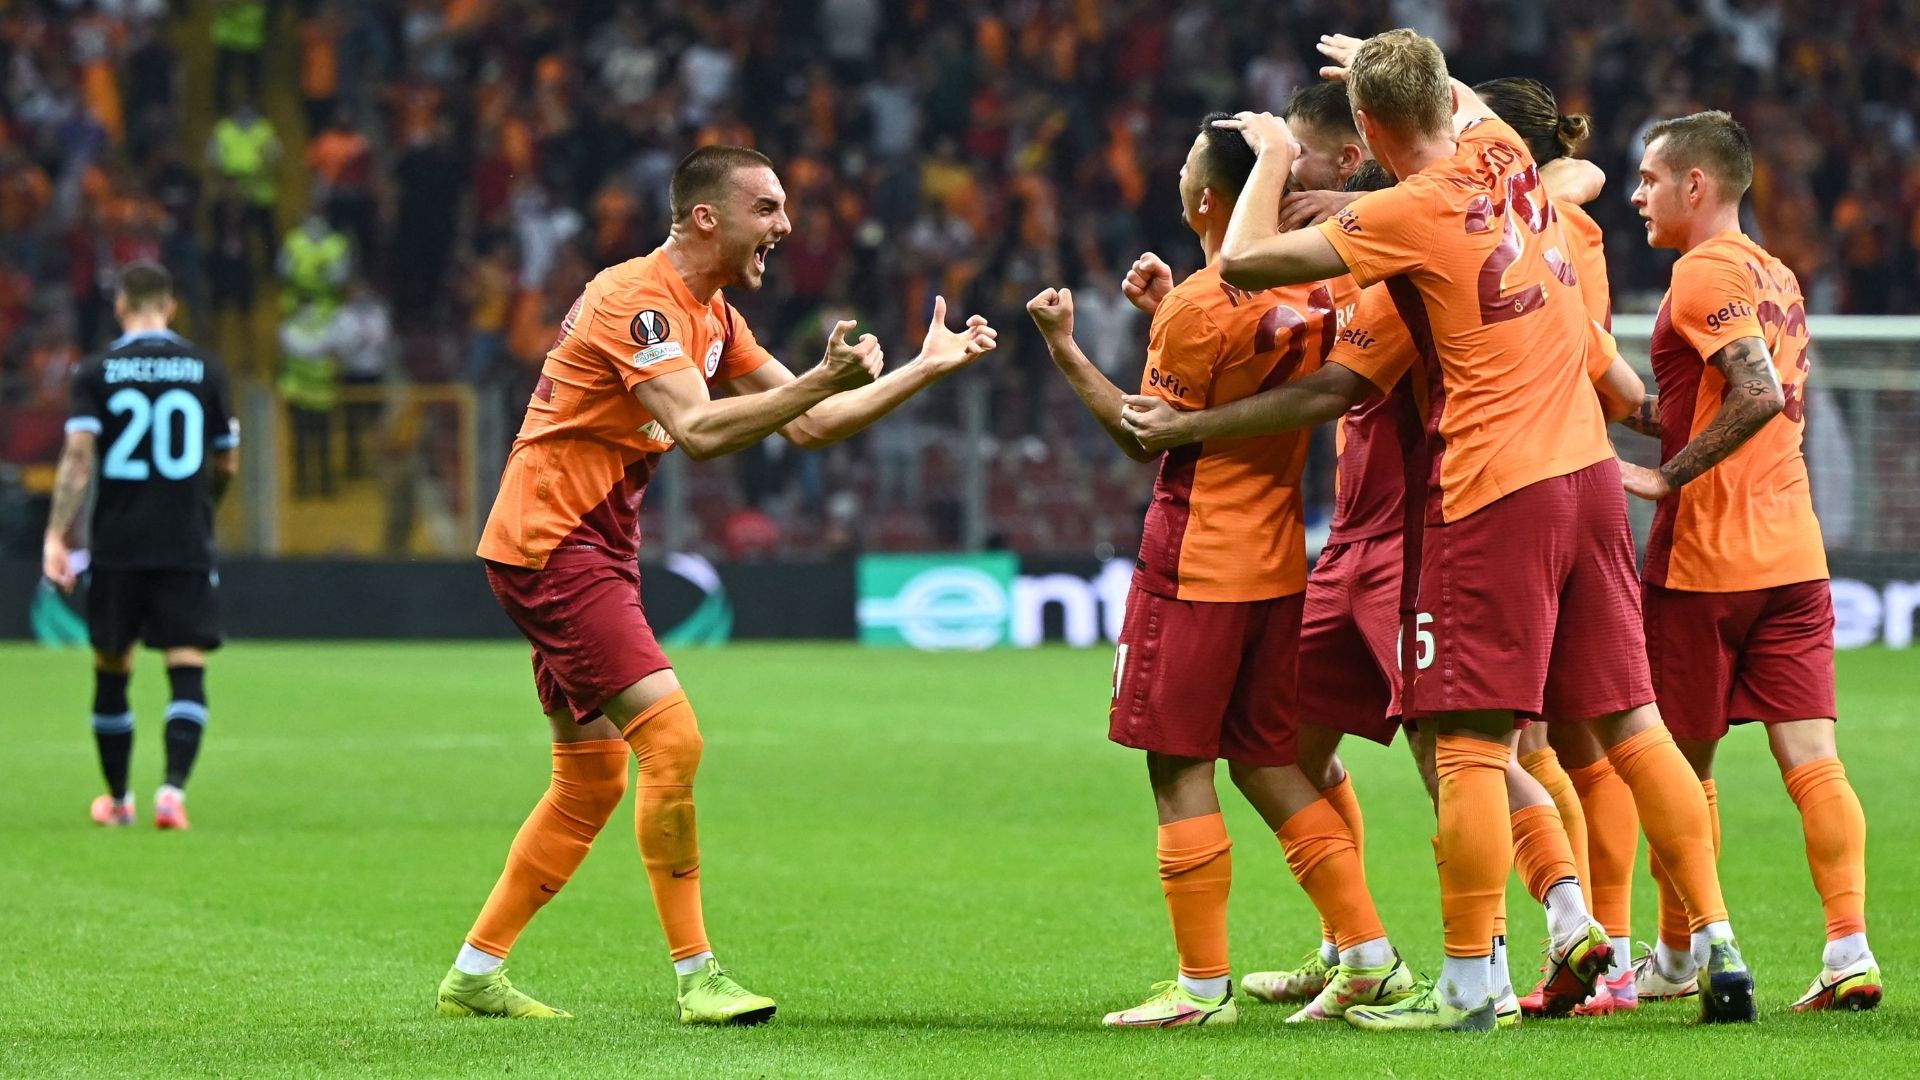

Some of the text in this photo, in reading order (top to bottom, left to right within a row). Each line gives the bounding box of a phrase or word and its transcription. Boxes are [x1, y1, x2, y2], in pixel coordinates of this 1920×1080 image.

[1706, 301, 1753, 332] getir
[635, 346, 681, 363] FOUNDATION
[103, 387, 204, 480] 20
